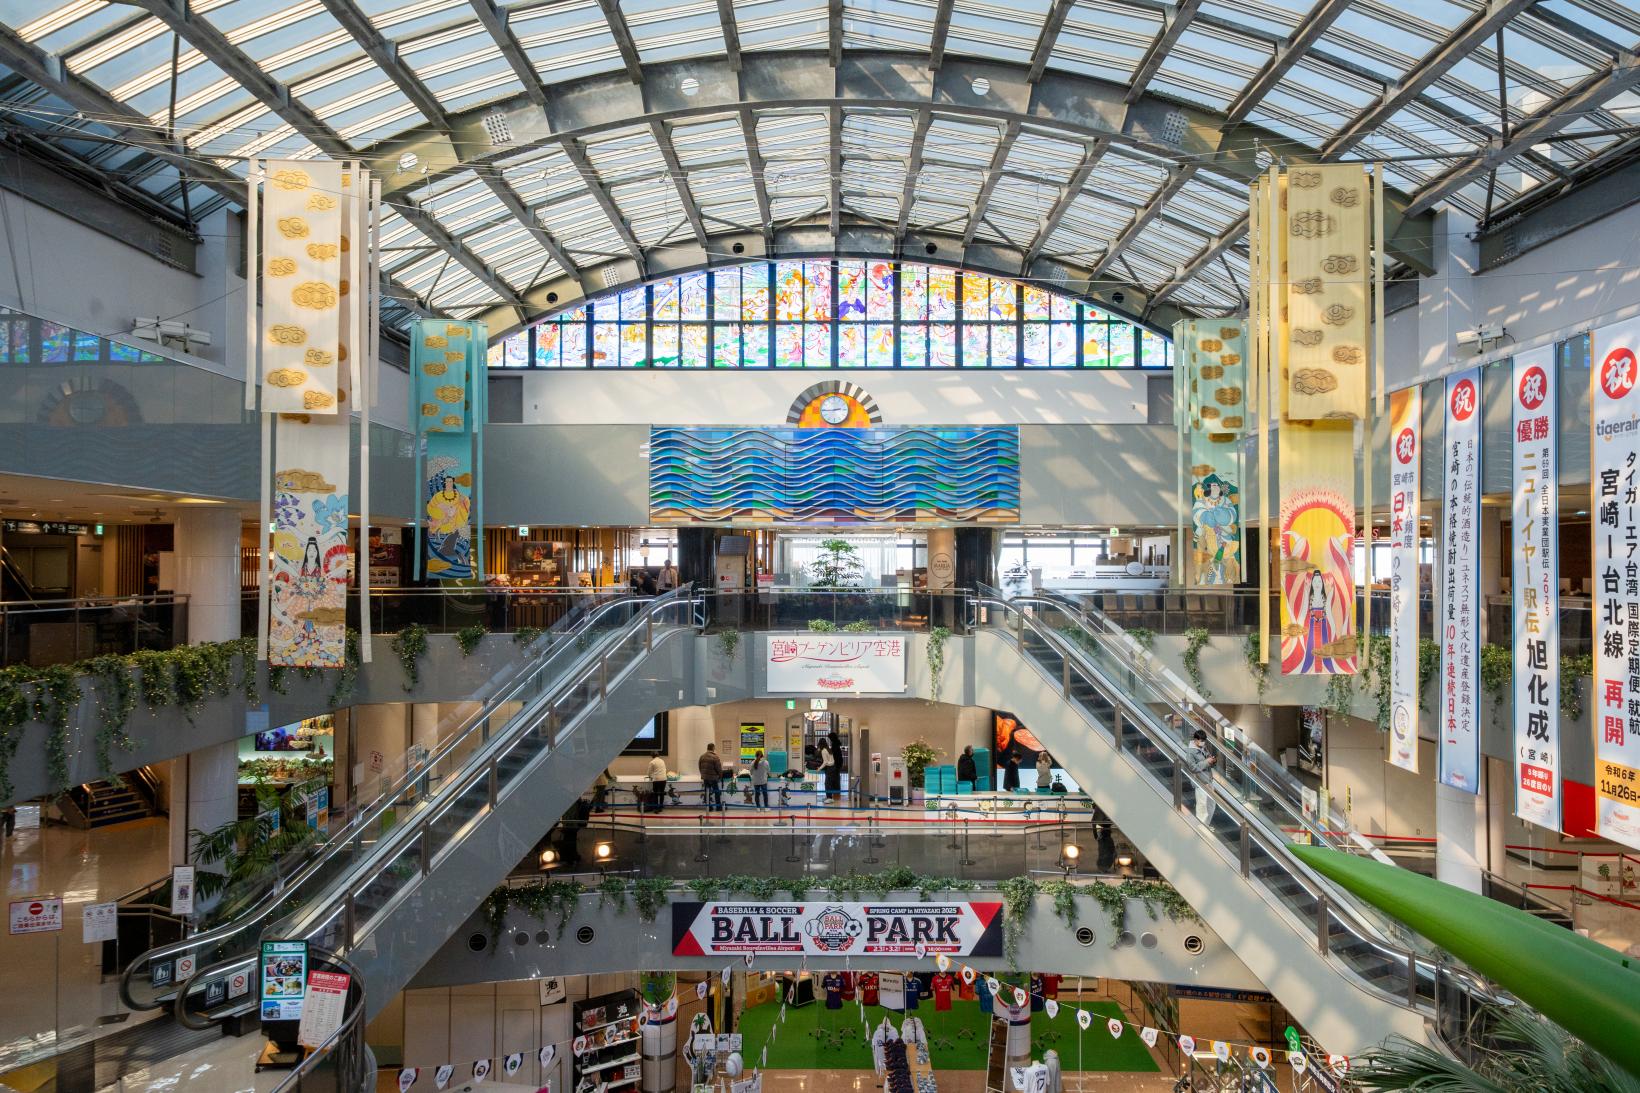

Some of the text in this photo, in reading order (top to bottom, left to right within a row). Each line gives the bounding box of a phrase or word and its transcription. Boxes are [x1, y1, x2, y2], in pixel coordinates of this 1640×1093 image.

[1523, 373, 1545, 402] 祝
[1605, 355, 1633, 394] 祝
[1455, 387, 1473, 415] 祝
[1517, 416, 1549, 443] 優勝
[1595, 411, 1640, 441] tigerair
[1400, 434, 1414, 459] 祝
[1393, 471, 1414, 485] 宮崎市
[771, 639, 900, 658] 宮崎ブーゲンビリア空港
[815, 699, 823, 709] A
[1605, 764, 1635, 782] 令和6年
[712, 916, 801, 943] BALL
[867, 916, 960, 944] PARK
